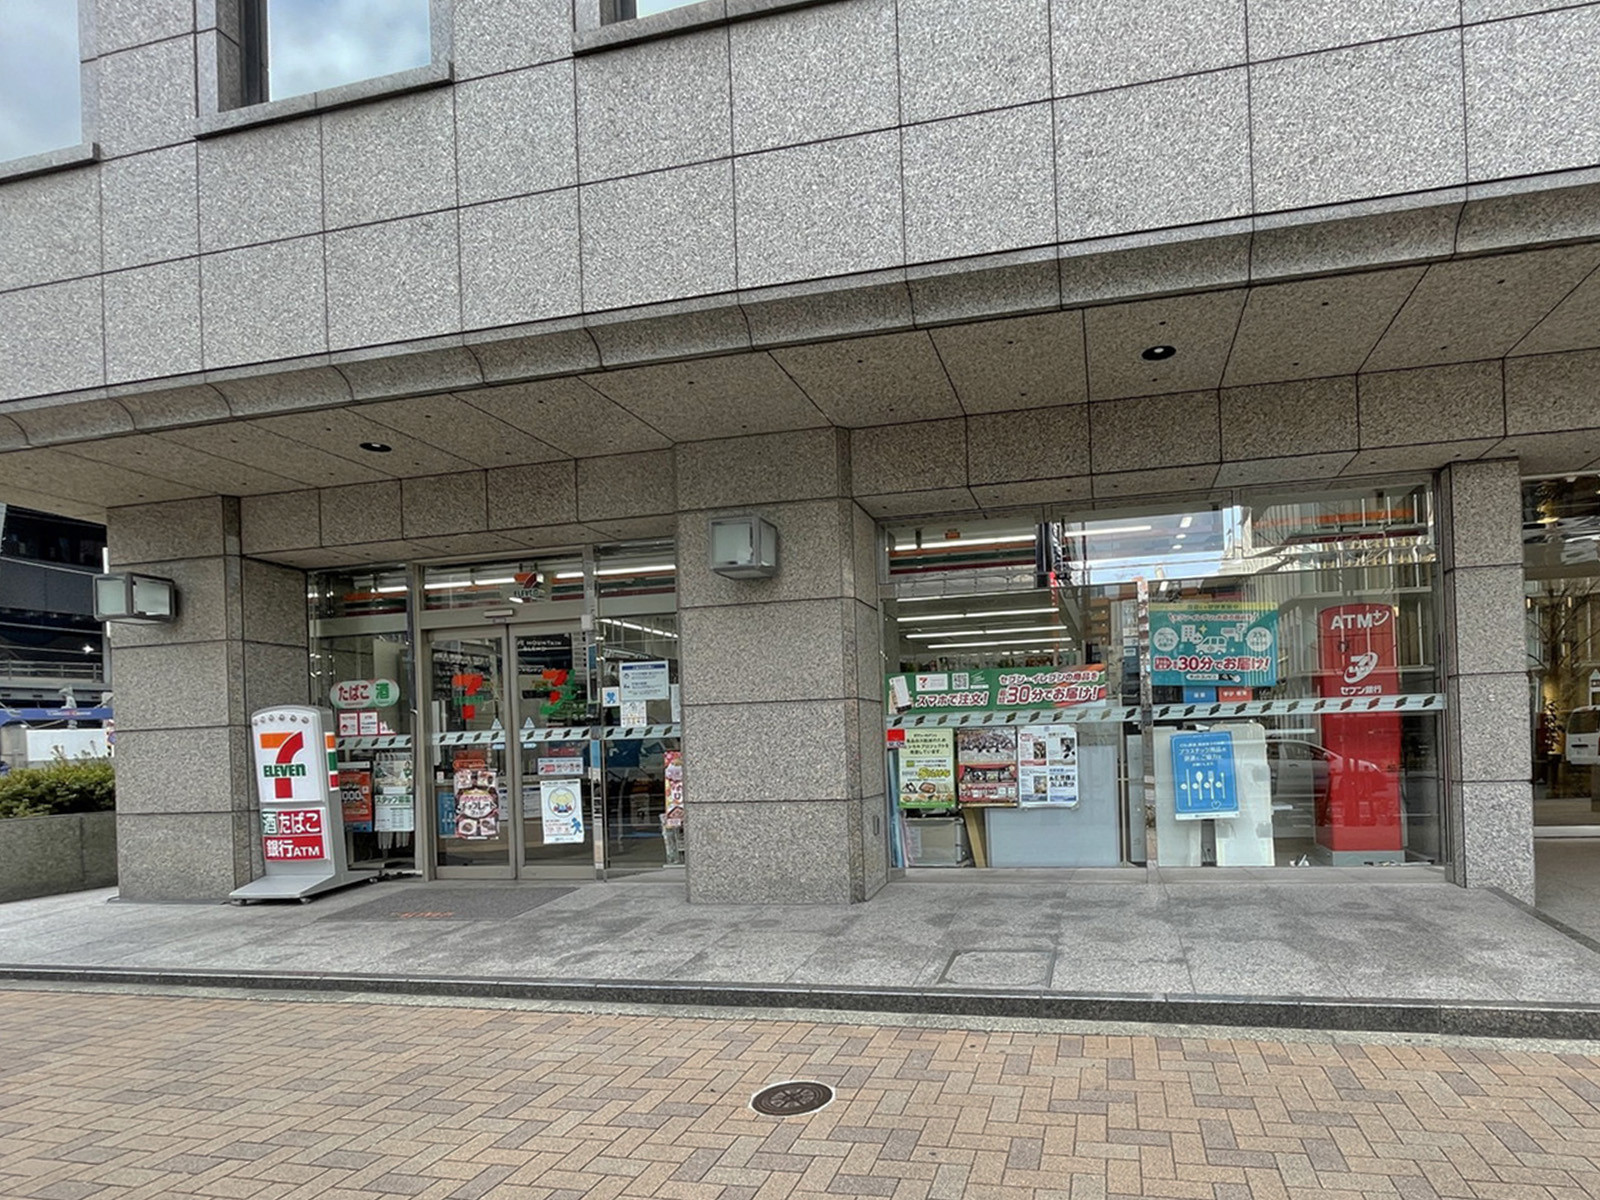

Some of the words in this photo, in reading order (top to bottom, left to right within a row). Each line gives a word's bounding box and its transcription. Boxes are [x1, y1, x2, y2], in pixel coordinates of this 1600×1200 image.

[338, 684, 370, 701] たばこ
[376, 683, 389, 699] 酒
[1341, 685, 1381, 695] セブン銀行
[916, 692, 988, 707] スマホで注文!
[263, 813, 277, 833] 酒
[279, 813, 320, 834] たばこ
